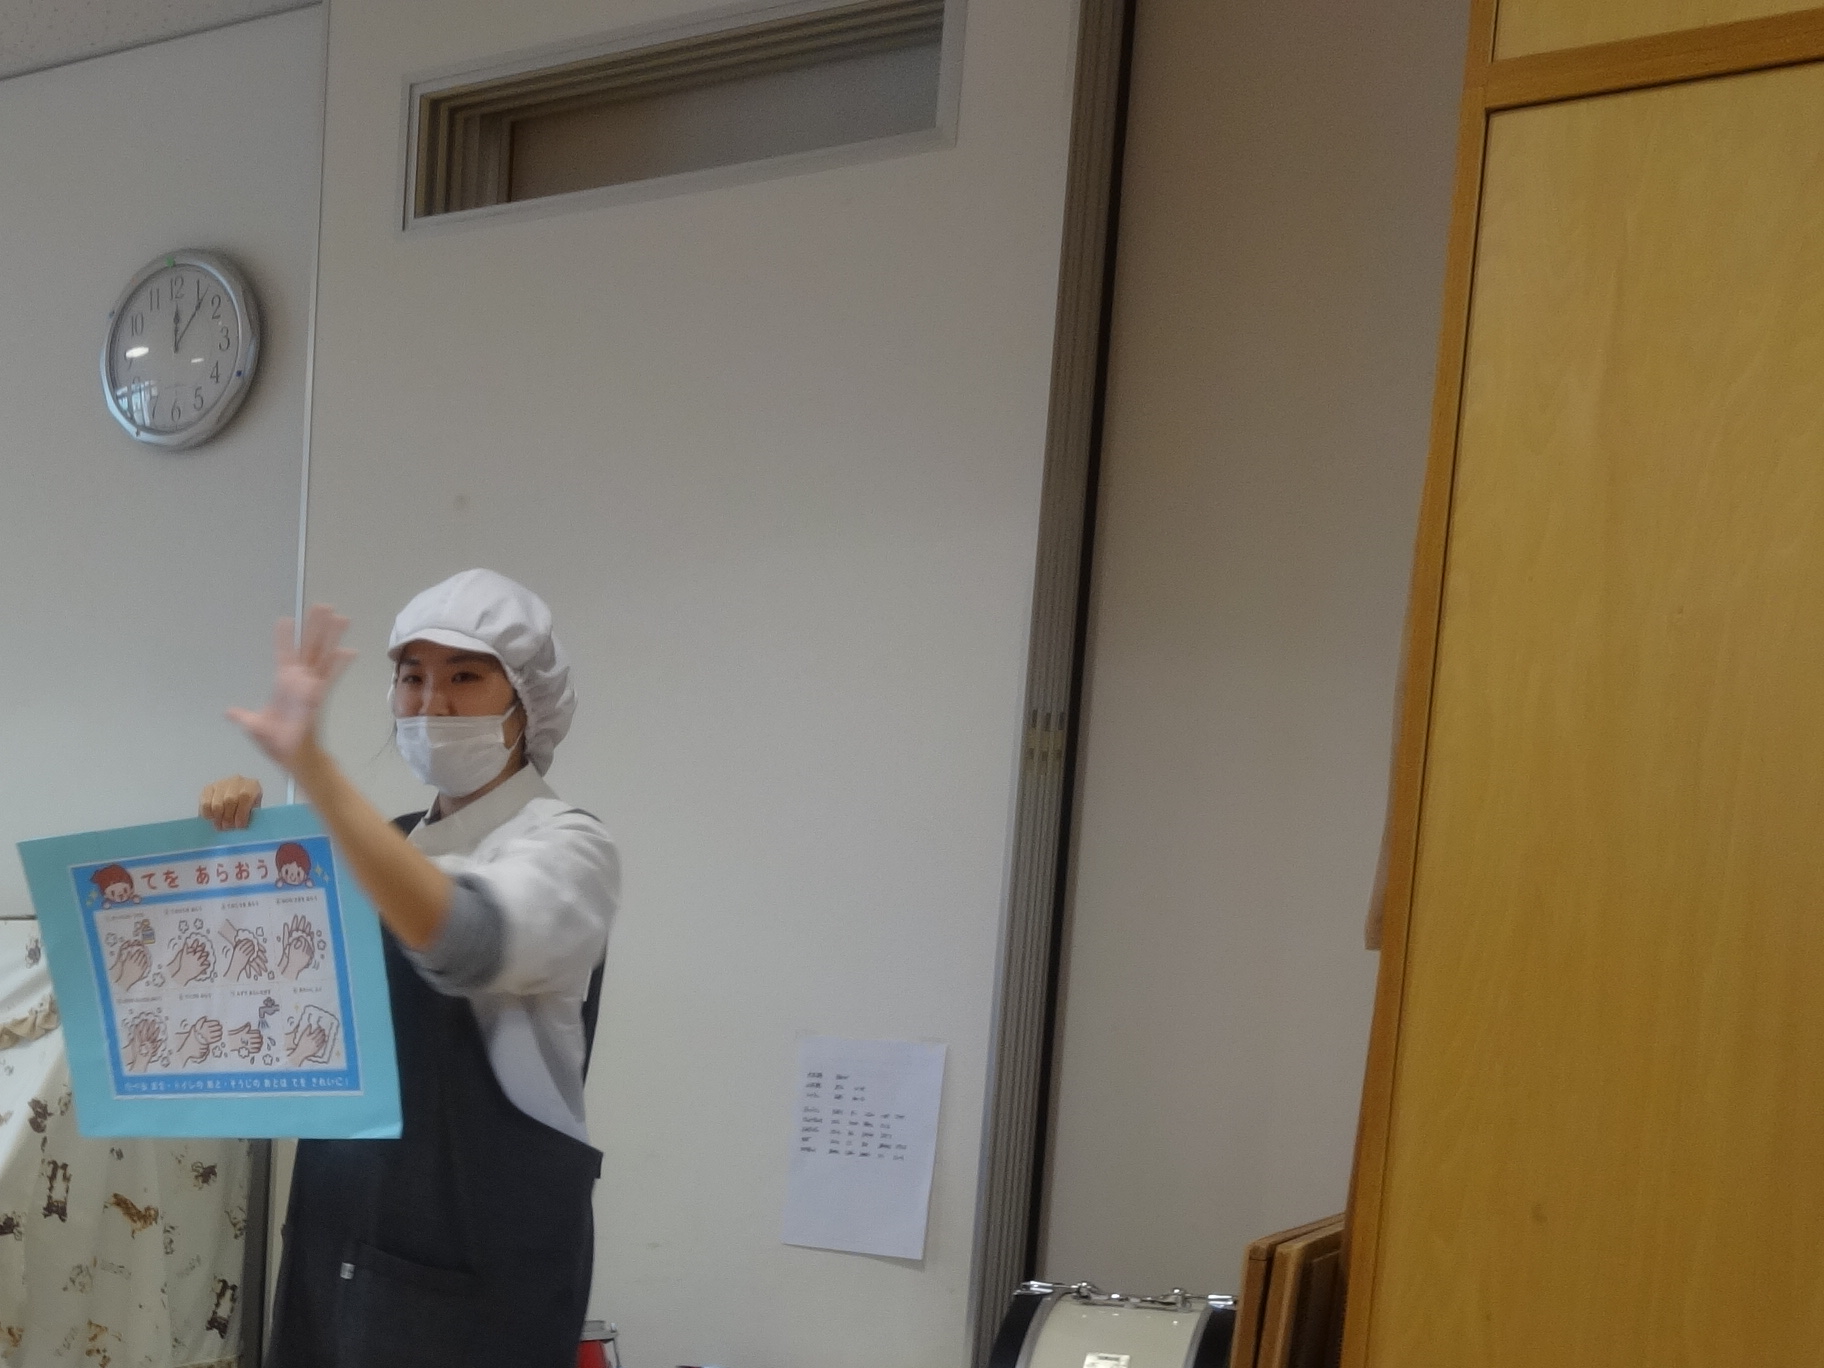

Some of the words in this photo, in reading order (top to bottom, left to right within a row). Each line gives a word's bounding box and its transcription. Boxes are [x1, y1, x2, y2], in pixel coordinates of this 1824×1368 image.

[150, 288, 160, 311] 11
[170, 276, 185, 300] 12
[211, 294, 222, 320] 2
[131, 313, 144, 337] 10
[218, 326, 230, 351] 3
[209, 360, 220, 384] 4
[171, 399, 182, 422] 6
[193, 386, 204, 411] 5
[140, 869, 180, 890] てを
[195, 858, 269, 885] あらおう
